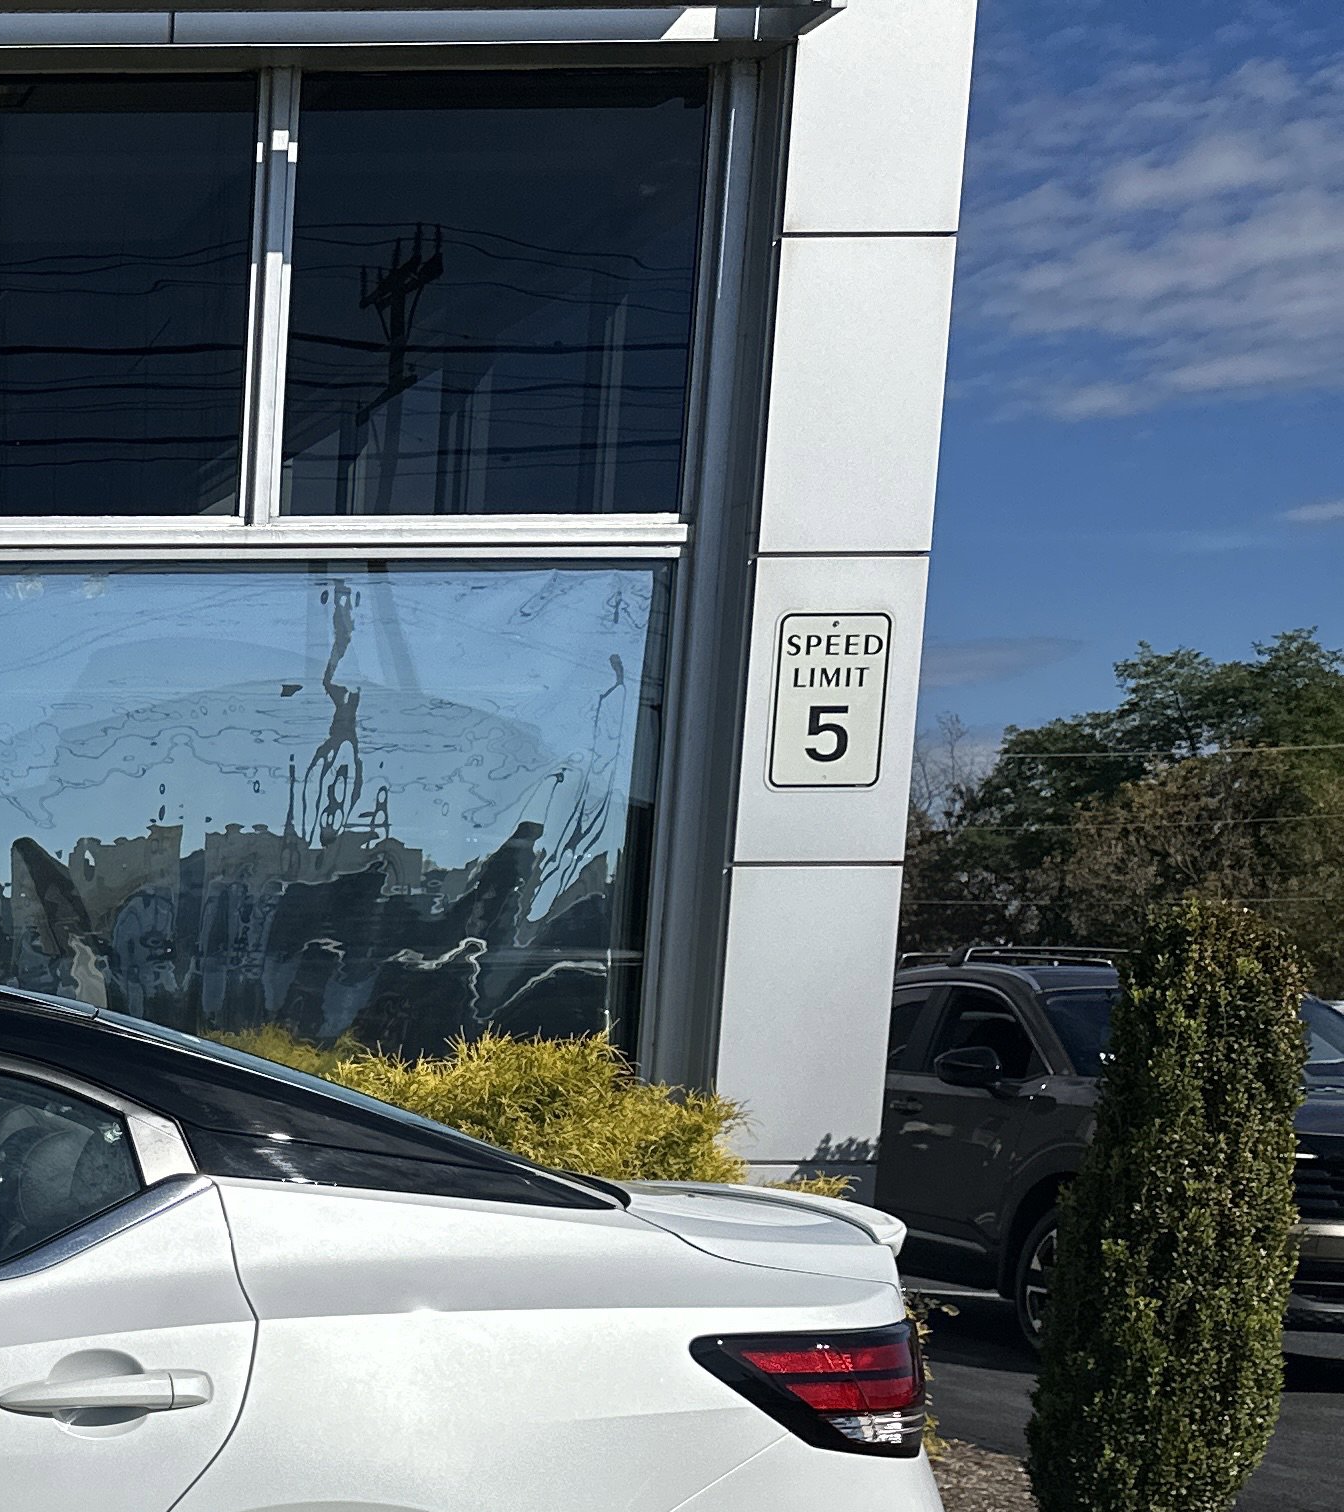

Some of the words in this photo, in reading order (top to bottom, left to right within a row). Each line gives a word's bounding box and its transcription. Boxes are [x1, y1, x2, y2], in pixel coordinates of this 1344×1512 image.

[786, 634, 884, 656] SPEED
[792, 667, 870, 688] LIMIT
[804, 705, 850, 763] 5
